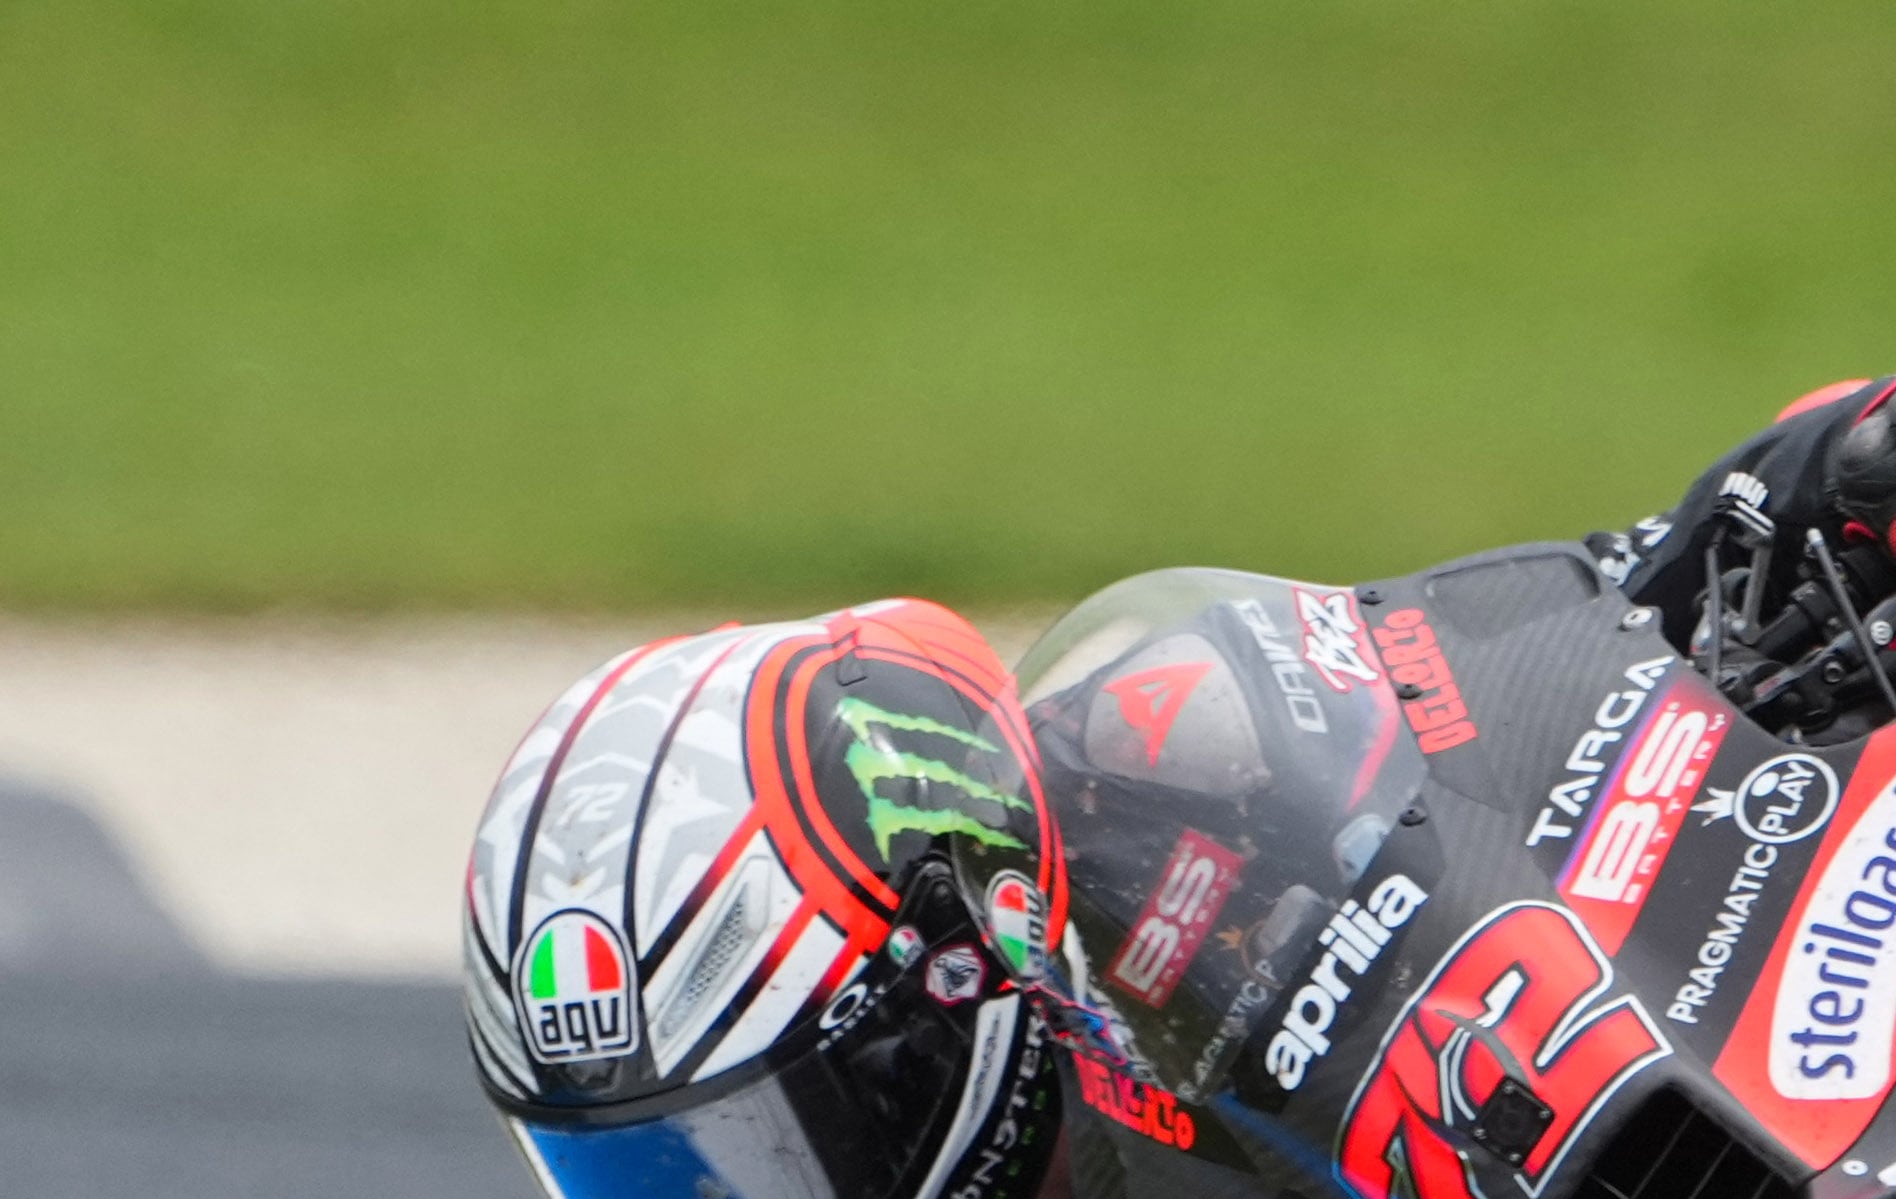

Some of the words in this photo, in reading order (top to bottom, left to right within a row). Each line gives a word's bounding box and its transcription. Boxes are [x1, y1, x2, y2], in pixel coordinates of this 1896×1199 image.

[1527, 656, 1674, 846] TARGA
[1573, 709, 1707, 901] BS
[1266, 874, 1428, 1091] aprilia
[1667, 845, 1778, 1024] PRAGMATIC
[1760, 761, 1815, 835] PLAY
[539, 995, 622, 1045] agv
